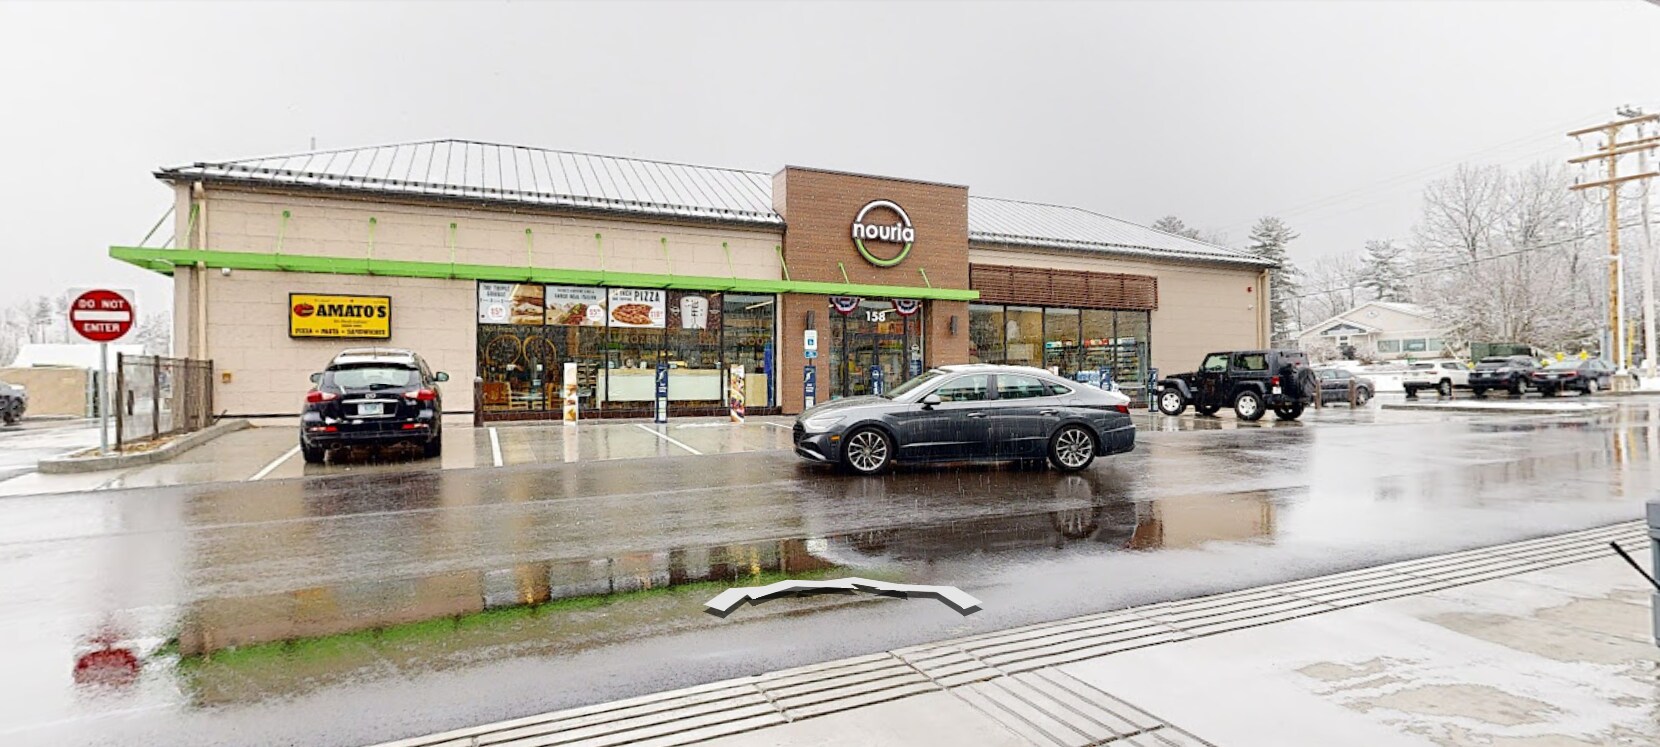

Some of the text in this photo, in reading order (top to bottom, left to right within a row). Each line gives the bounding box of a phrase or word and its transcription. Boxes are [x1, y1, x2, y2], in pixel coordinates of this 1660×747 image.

[853, 222, 915, 242] nouria
[634, 290, 661, 302] PIZZA
[78, 299, 125, 309] DO NOT
[316, 304, 387, 318] AMATO'S
[866, 311, 886, 321] 158
[83, 323, 120, 333] ENTER
